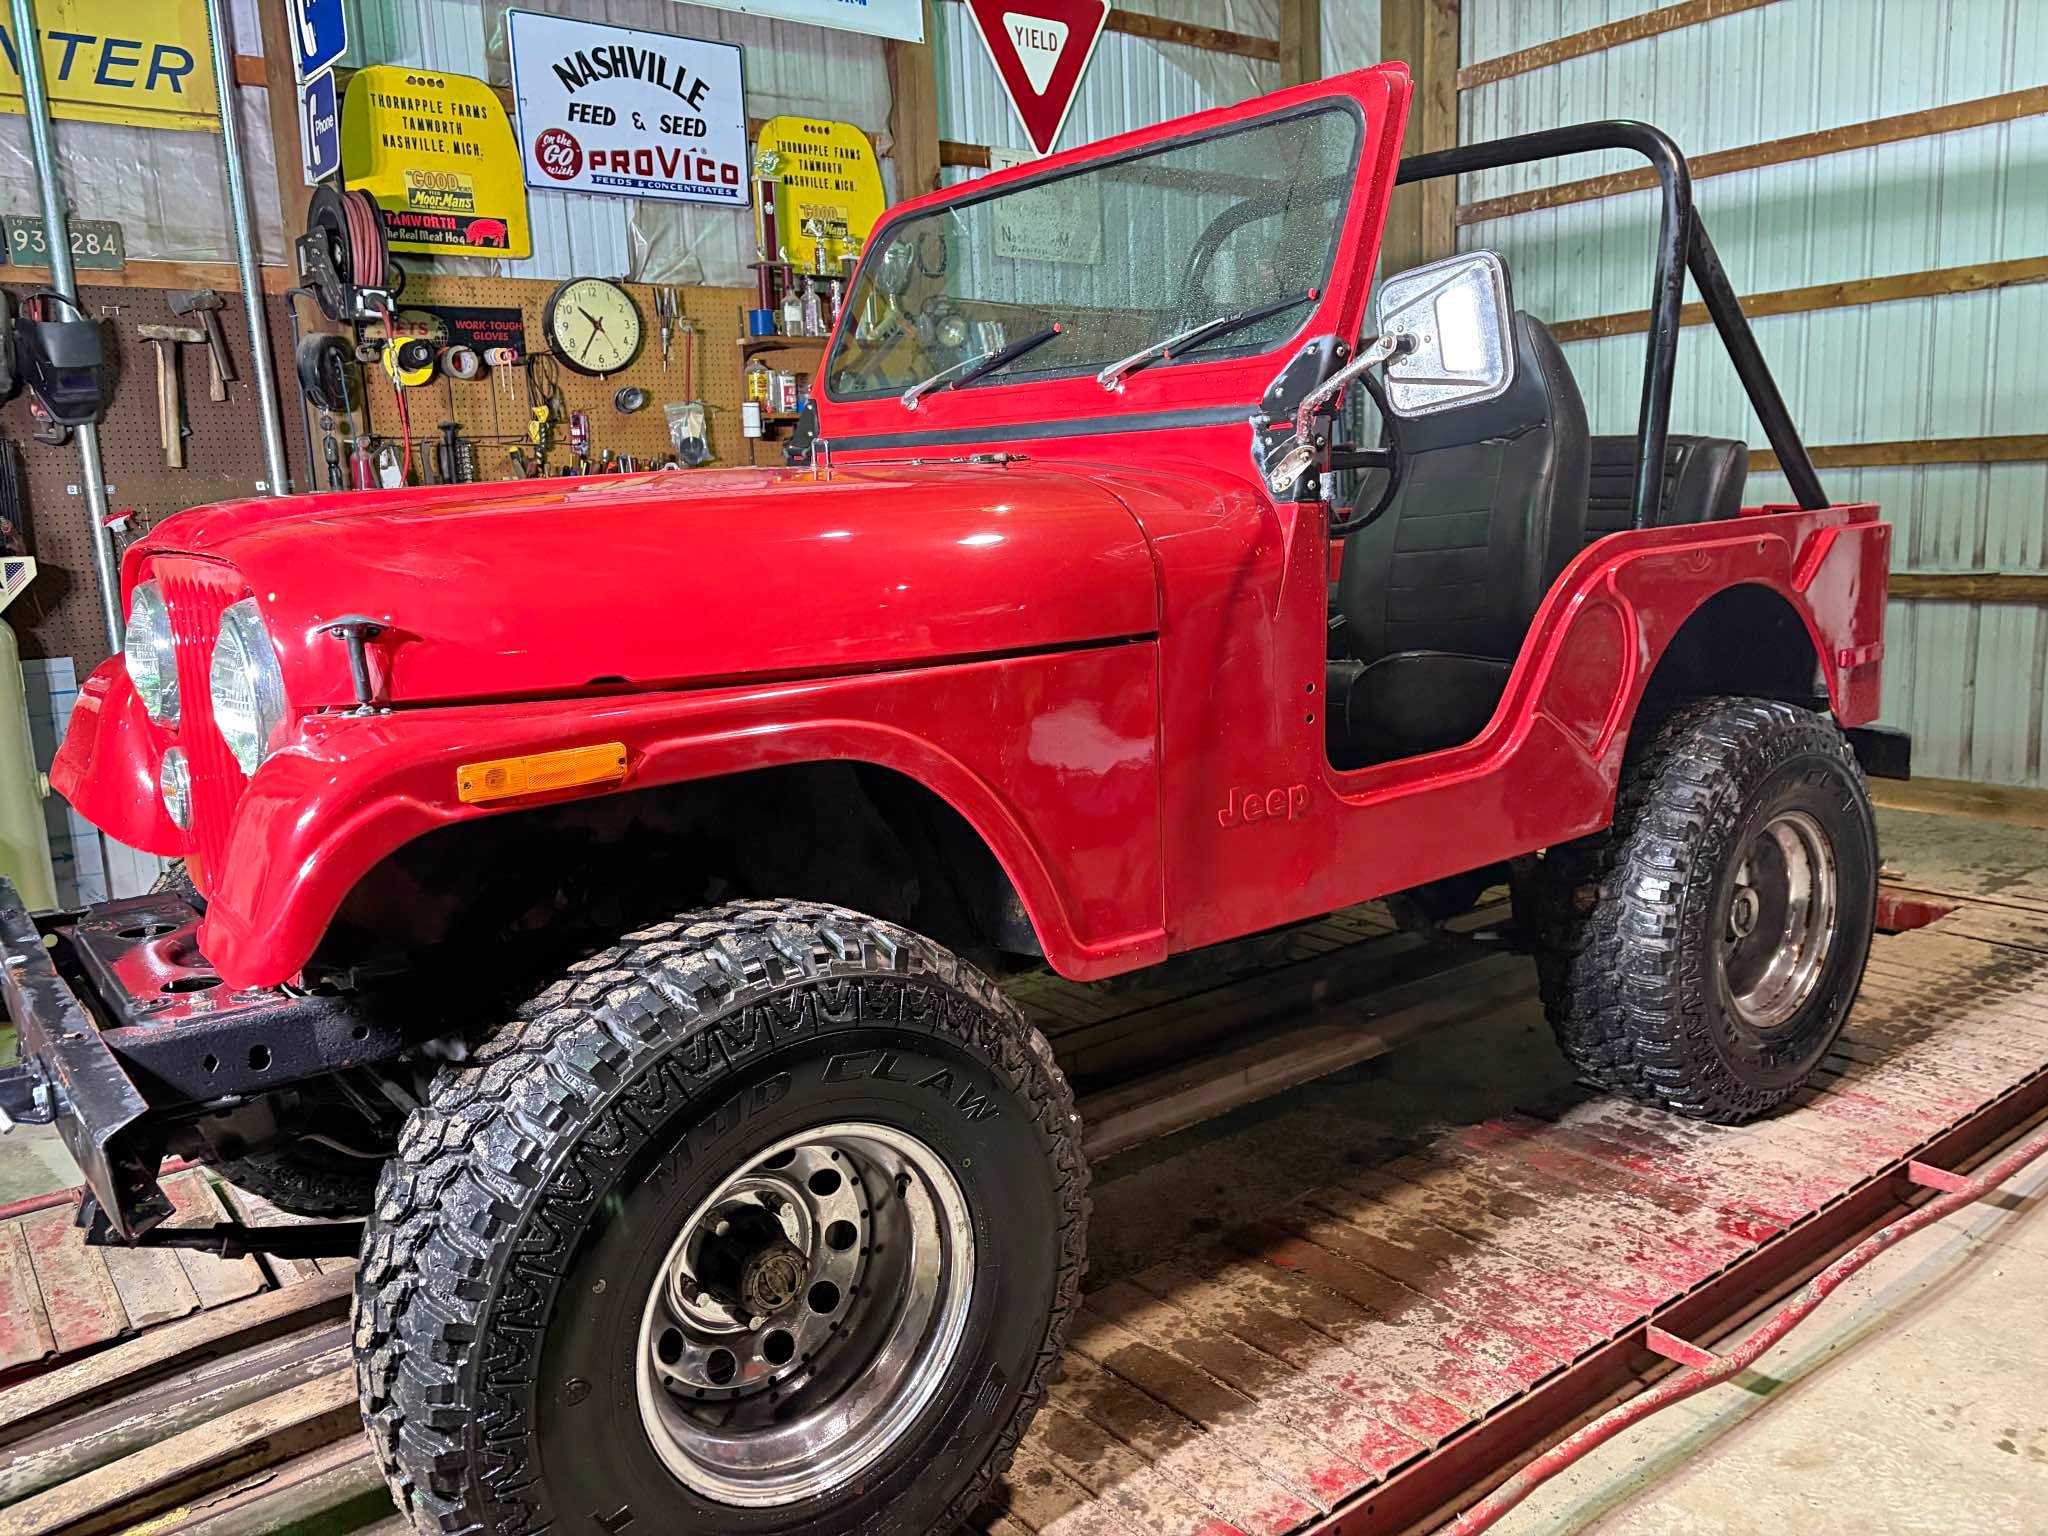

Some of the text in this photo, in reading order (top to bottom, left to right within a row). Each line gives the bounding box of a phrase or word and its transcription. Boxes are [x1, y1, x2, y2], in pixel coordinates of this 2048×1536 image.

[1014, 25, 1058, 52] YIELD
[552, 45, 710, 112] NASHVILLE
[370, 93, 487, 119] THORNAPPLE FARMS
[315, 114, 334, 137] Phone
[402, 116, 463, 135] TAMWORTH
[568, 102, 707, 137] FEED & SEED
[556, 133, 572, 147] the
[453, 141, 484, 157] MICH.
[543, 144, 575, 166] GO
[776, 140, 861, 160] THORNAPPLE FARMS
[546, 165, 574, 176] with
[799, 159, 843, 174] TAMWORTH
[412, 171, 459, 191] GOOD
[596, 175, 633, 186] FEEDS
[648, 181, 732, 196] CONCENTRATES
[835, 181, 857, 192] MICH.
[385, 213, 457, 230] TAMWORTH
[399, 228, 418, 240] Real
[419, 229, 443, 242] Meat
[445, 232, 466, 245] Hog
[588, 287, 597, 297] 12
[562, 305, 572, 315] 10
[618, 304, 624, 313] 2
[562, 322, 569, 331] 9
[624, 320, 630, 329] 3
[473, 331, 509, 342] GLOVES
[569, 338, 576, 348] 8
[623, 336, 629, 345] 4
[598, 354, 605, 363] 6
[613, 348, 619, 358] 5
[1217, 784, 1309, 827] Jeep
[821, 1049, 1000, 1122] CLAW
